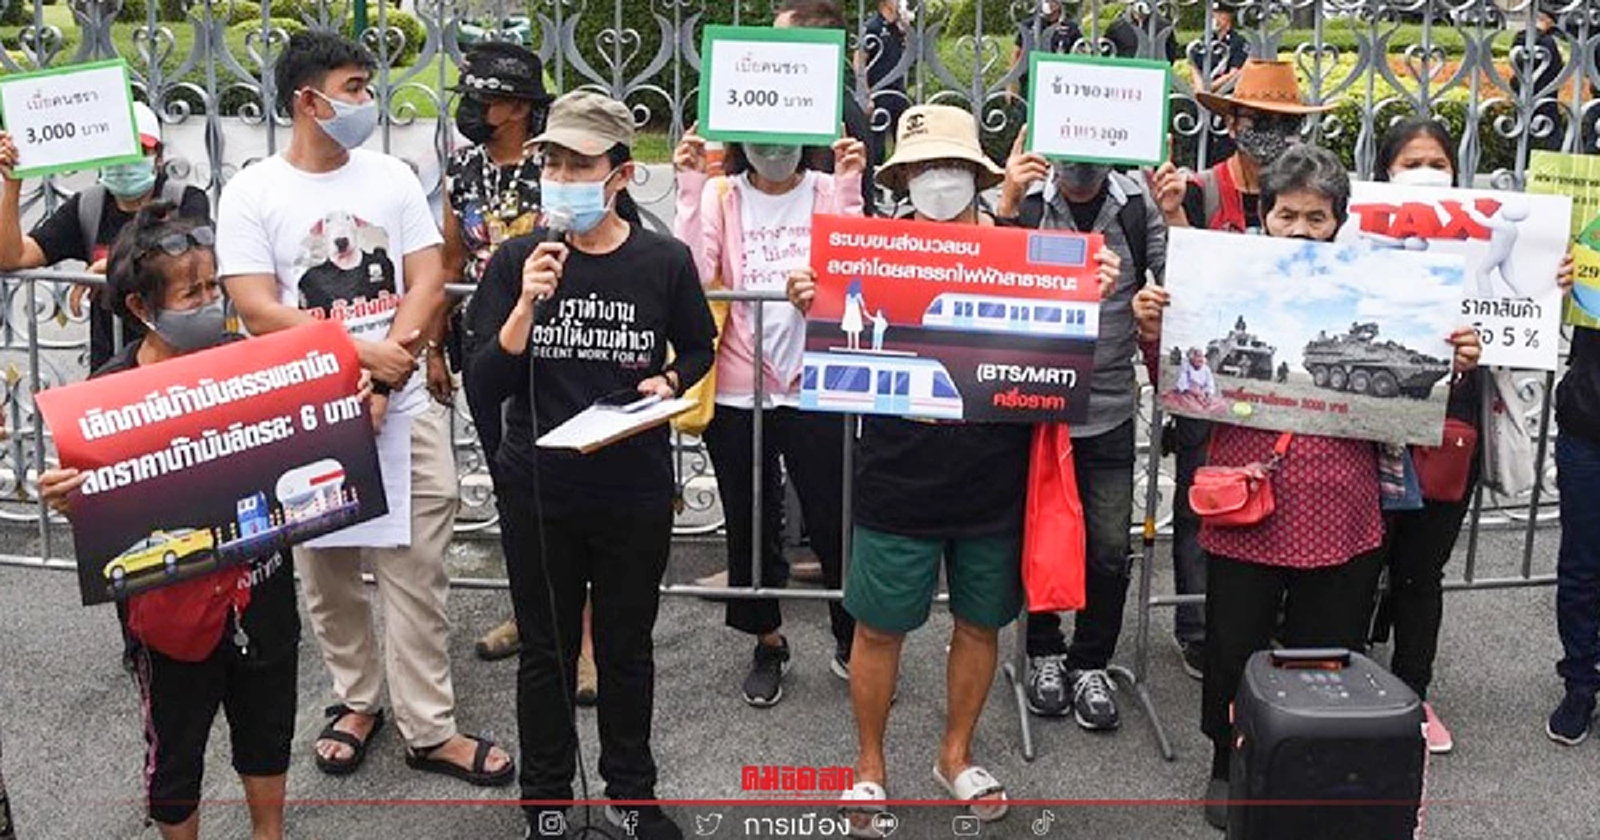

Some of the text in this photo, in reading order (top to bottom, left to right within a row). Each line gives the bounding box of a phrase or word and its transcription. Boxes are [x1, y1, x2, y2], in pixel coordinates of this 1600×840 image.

[727, 89, 814, 108] 3,000 บาท
[26, 121, 110, 144] 3,000 บาท
[1349, 198, 1503, 242] TAX
[829, 231, 981, 257] ระบบขนส่งมวลชน
[827, 258, 1078, 291] ลดค่าโดยสารรถไฟฟ้าสาธารณะ
[1578, 265, 1600, 278] 29
[558, 292, 636, 323] เราทำงาน
[1461, 297, 1542, 319] ราคาสินค้า
[533, 318, 656, 351] อย่าให้งานทำเรา
[1502, 328, 1515, 346] 5
[1525, 328, 1540, 349] %
[533, 346, 573, 359] DECENT
[577, 349, 610, 361] WORK
[613, 351, 635, 363] FOR
[976, 363, 1077, 387] (BTS/MRT)
[77, 350, 340, 442] เลิกภาษีน้ำมันสรรพสามิต
[993, 388, 1066, 410] ครึ่งราคา
[302, 405, 318, 431] 6
[326, 397, 362, 425] บาท
